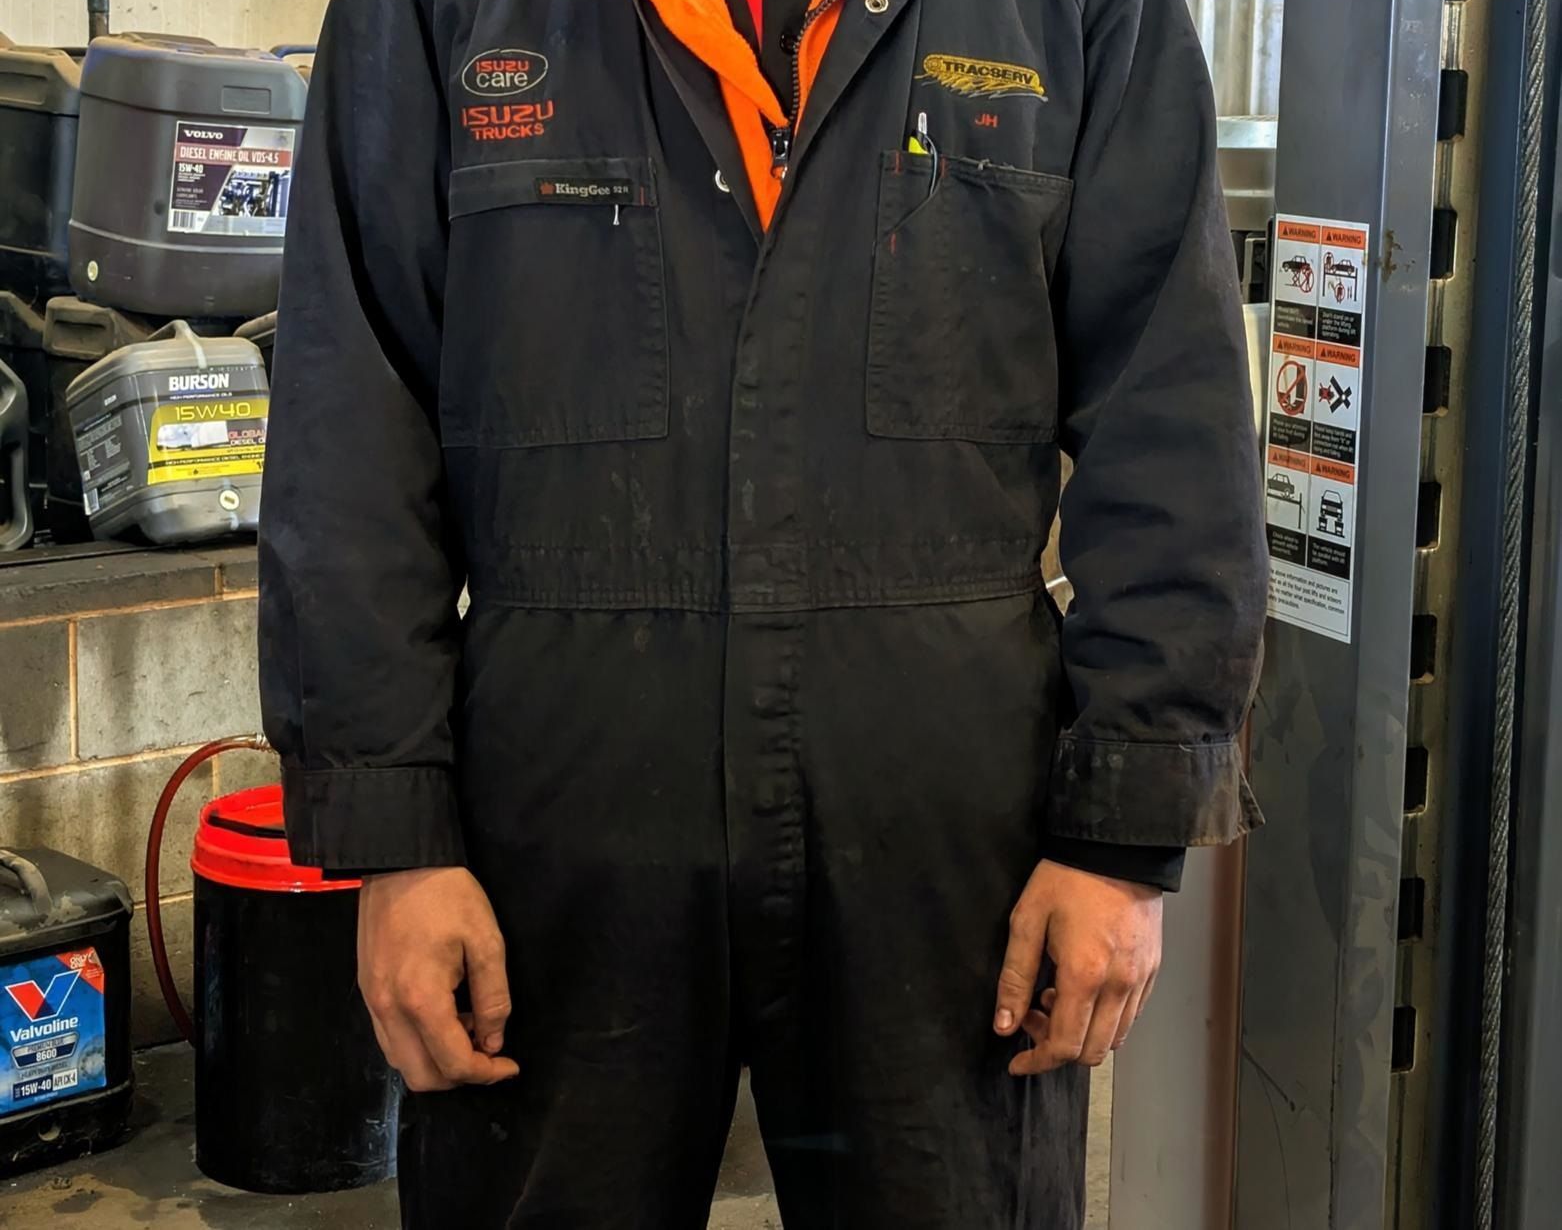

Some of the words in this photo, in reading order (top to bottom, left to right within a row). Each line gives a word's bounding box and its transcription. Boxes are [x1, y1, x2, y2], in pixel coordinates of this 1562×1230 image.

[476, 60, 529, 72] ISUZU
[943, 61, 1034, 85] TRACSERV
[476, 72, 528, 88] care
[462, 100, 554, 126] ISUZU
[975, 113, 998, 128] JH
[183, 129, 224, 139] VOLVO
[470, 123, 544, 140] TRUCKS
[180, 146, 207, 160] DIESEL
[209, 148, 237, 162] ENGINE
[238, 150, 249, 162] OIL
[251, 151, 279, 164] VDS-4.5
[178, 162, 204, 174] 15W-40
[1289, 227, 1316, 239] WARNING
[1332, 233, 1362, 244] WARNING
[1283, 341, 1311, 354] WARNING
[1326, 350, 1356, 362] WARNING
[169, 373, 230, 392] BURSON
[175, 402, 251, 421] 15W40
[1322, 464, 1350, 478] WARNING
[10, 1016, 79, 1043] Valvoline
[36, 1048, 57, 1062] 8600
[21, 1079, 52, 1096] 15W-40
